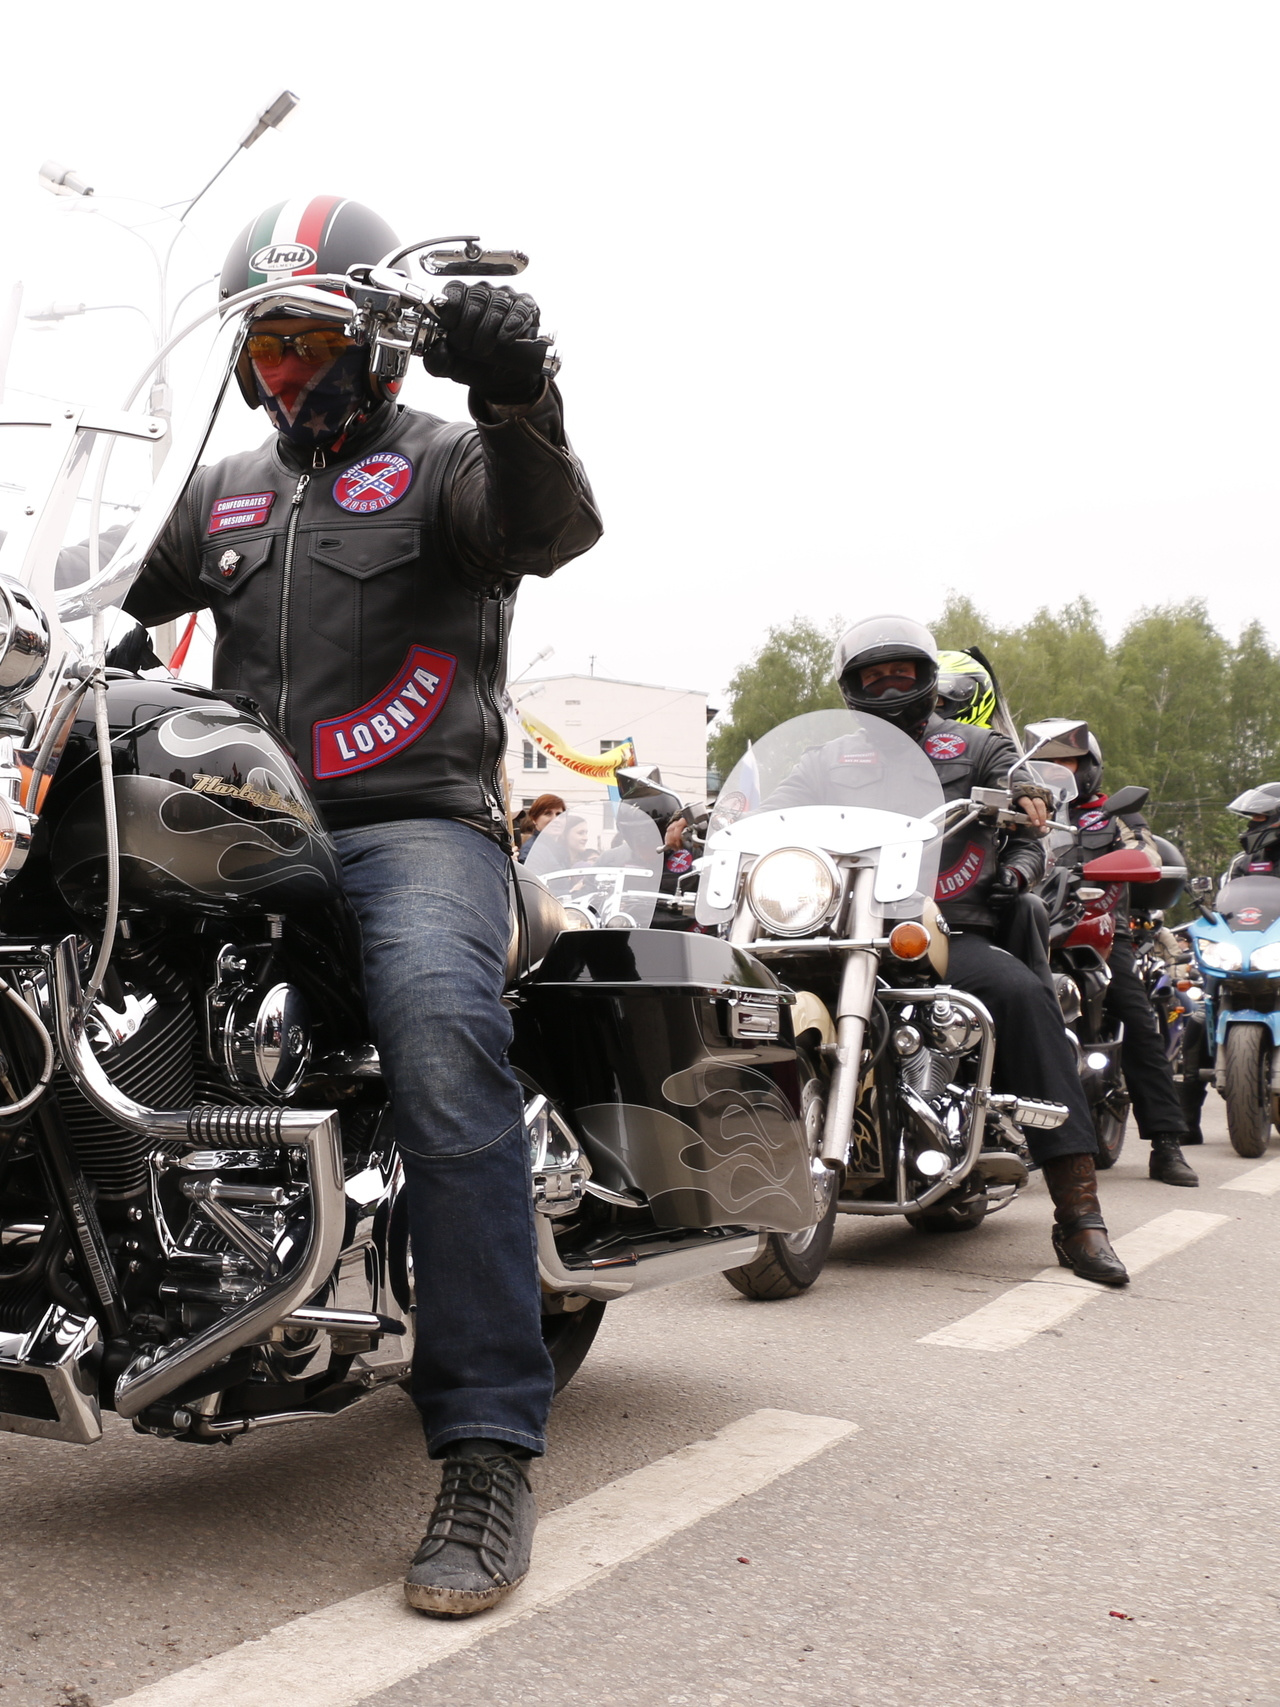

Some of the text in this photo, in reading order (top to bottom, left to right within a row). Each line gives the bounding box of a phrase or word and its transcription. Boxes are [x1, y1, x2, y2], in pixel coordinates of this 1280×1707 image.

[253, 248, 306, 267] Arai
[341, 454, 409, 479] CONFEDERATES
[217, 497, 267, 511] CONFEDERATES
[341, 494, 397, 511] RUSSIA
[219, 513, 255, 527] PRESIDENT
[334, 668, 440, 760] LOBNYA
[938, 852, 980, 894] LOBNYA
[1094, 884, 1119, 910] OBNYA
